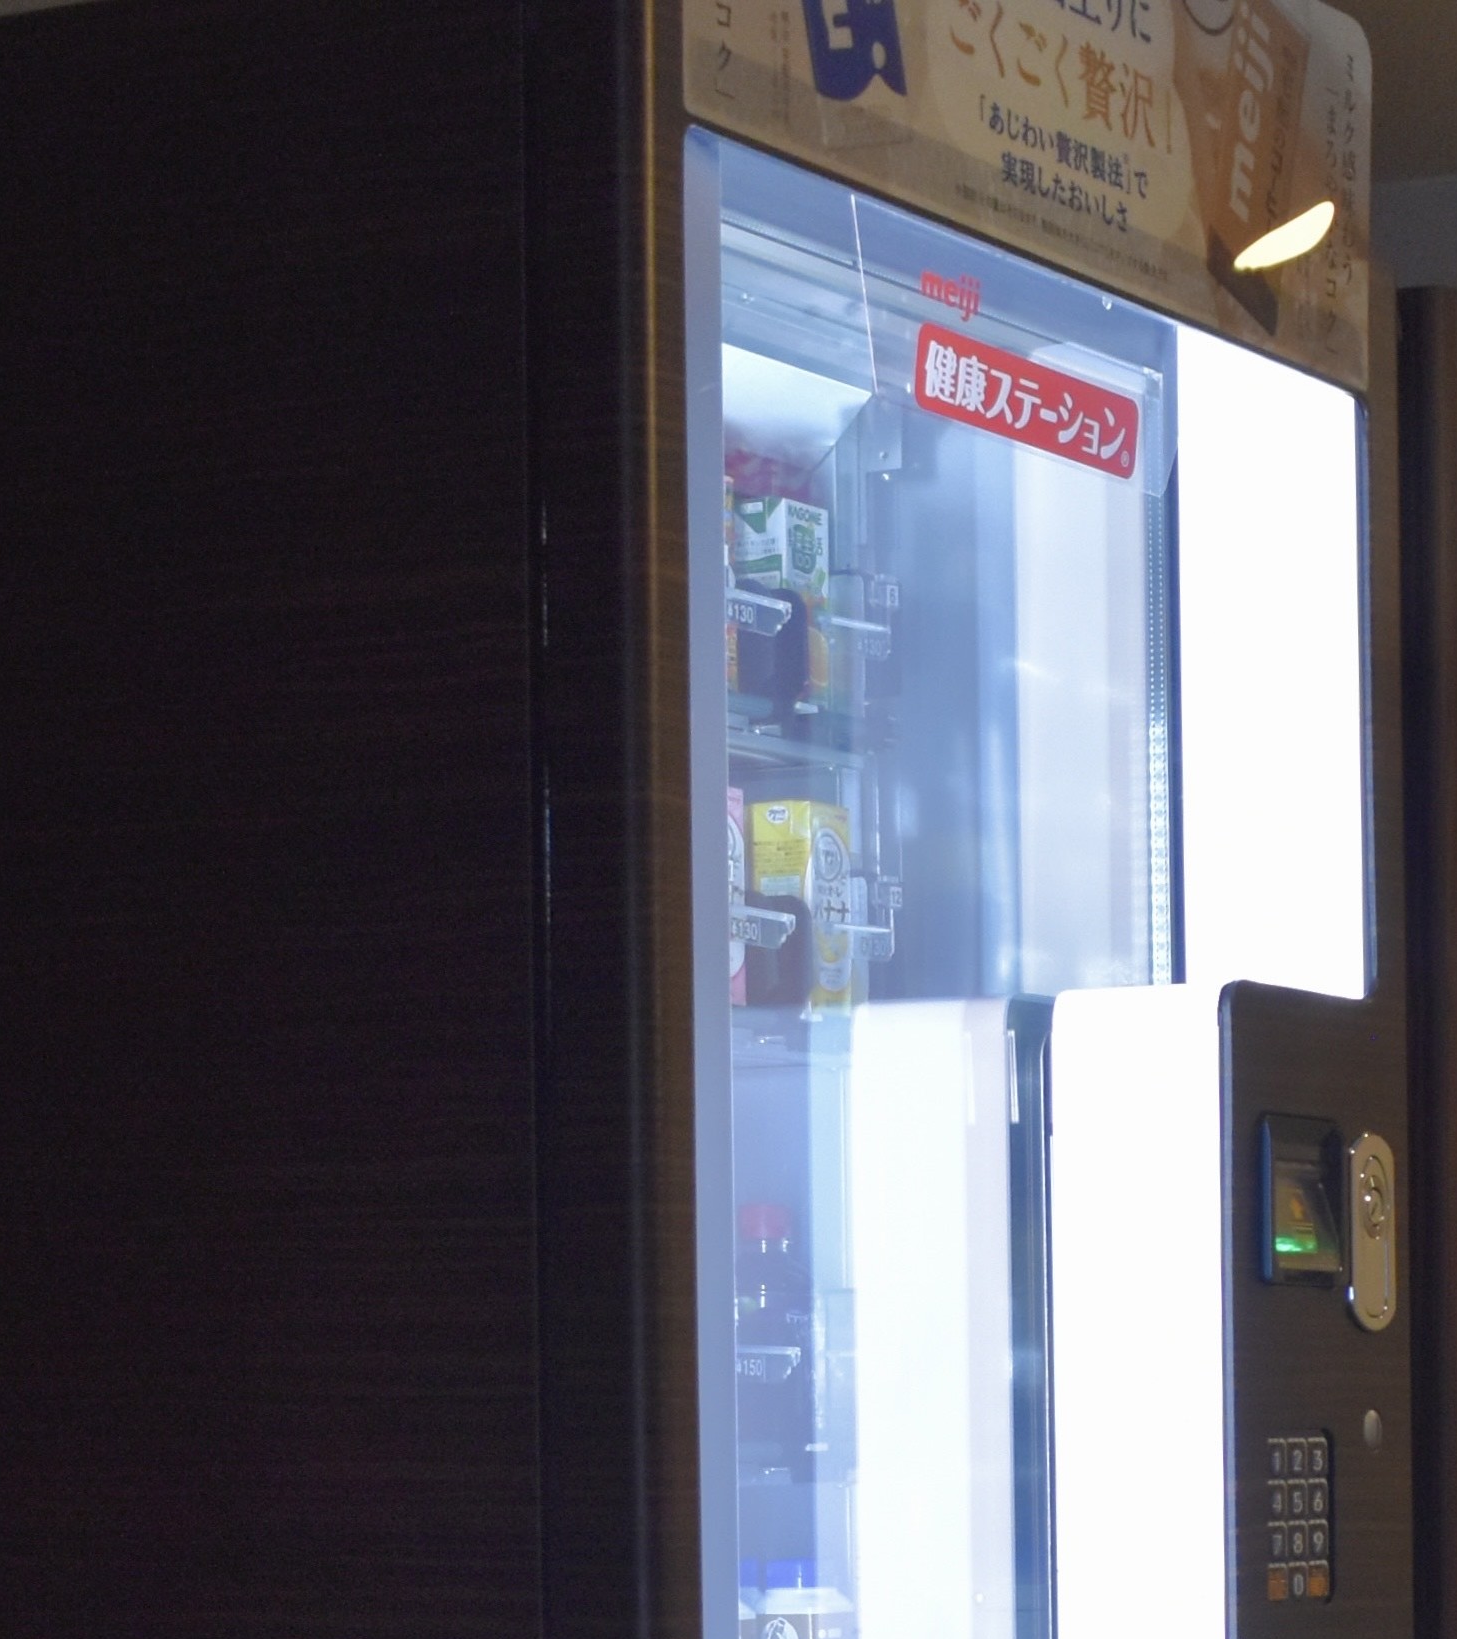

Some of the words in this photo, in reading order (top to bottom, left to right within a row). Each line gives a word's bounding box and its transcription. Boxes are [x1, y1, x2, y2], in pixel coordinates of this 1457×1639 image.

[1001, 151, 1128, 232] 実現したおいしさ
[919, 269, 981, 323] meiji
[1293, 1449, 1304, 1473] 2
[1312, 1448, 1324, 1472] 3
[1293, 1491, 1303, 1513] 5
[1313, 1491, 1324, 1513] 6
[1293, 1532, 1304, 1555] 8
[1313, 1531, 1325, 1554] 9
